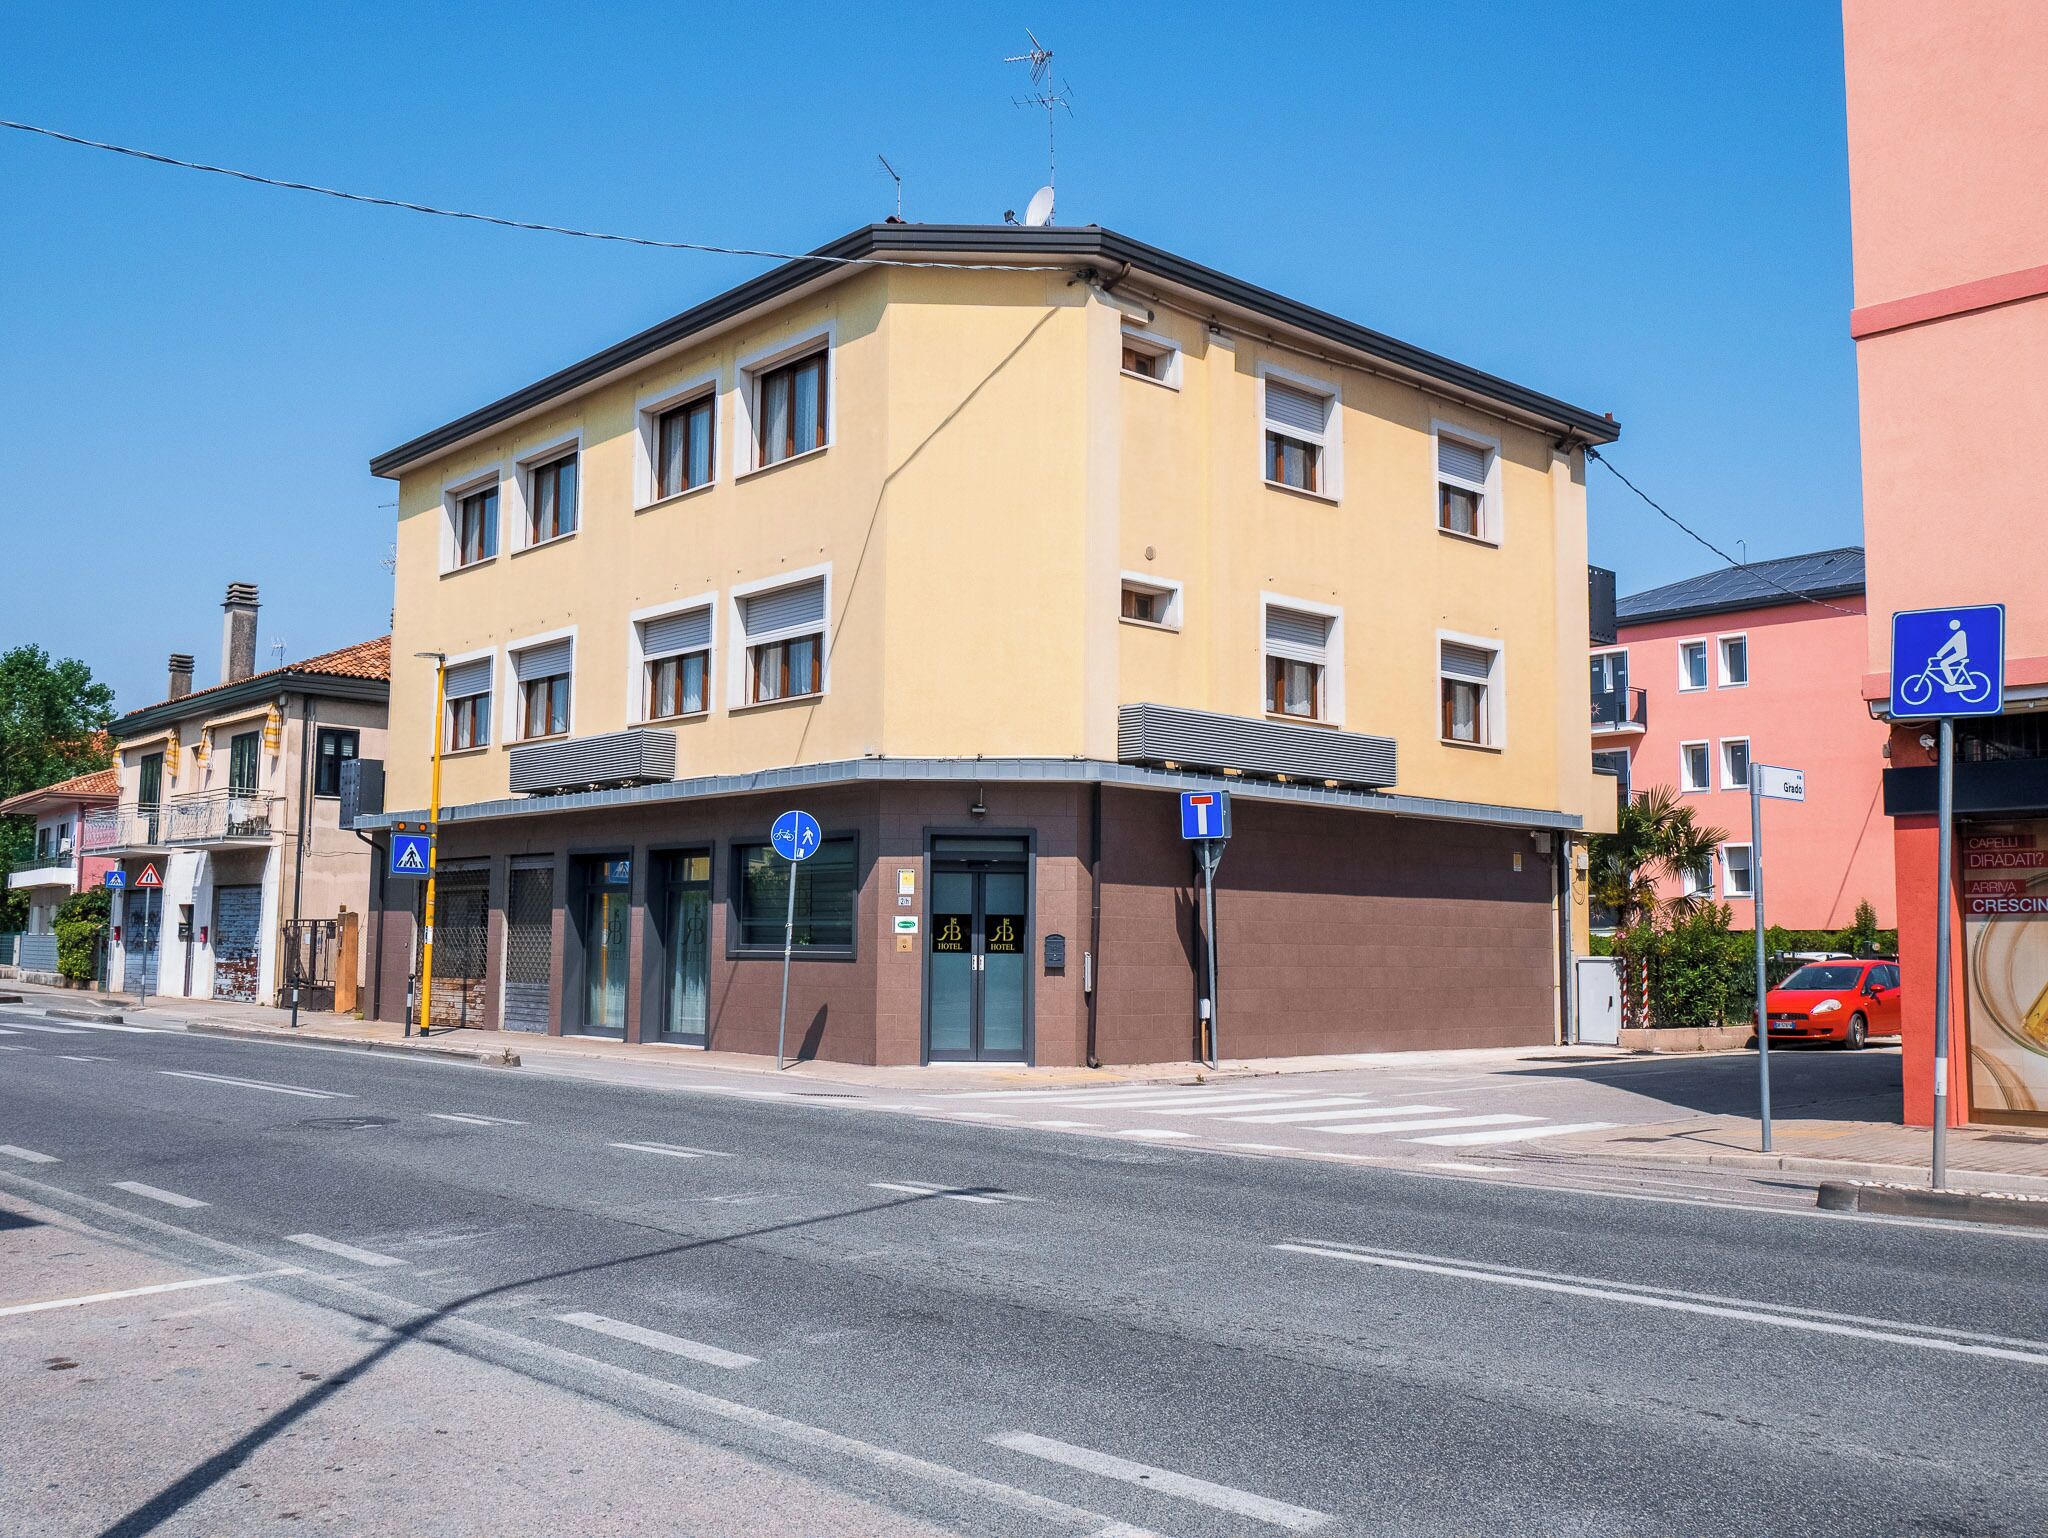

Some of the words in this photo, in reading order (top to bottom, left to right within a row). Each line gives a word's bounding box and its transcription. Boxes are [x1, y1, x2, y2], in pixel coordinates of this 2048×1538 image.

[1783, 782, 1803, 794] Grado
[1969, 837, 2018, 849] CAPELLI
[1970, 852, 2044, 868] DIRADATI?
[1971, 881, 2017, 893] ARRIVA
[1972, 898, 2048, 913] CRESCIN
[938, 942, 963, 950] HOTEL
[990, 943, 1015, 951] HOTEL
